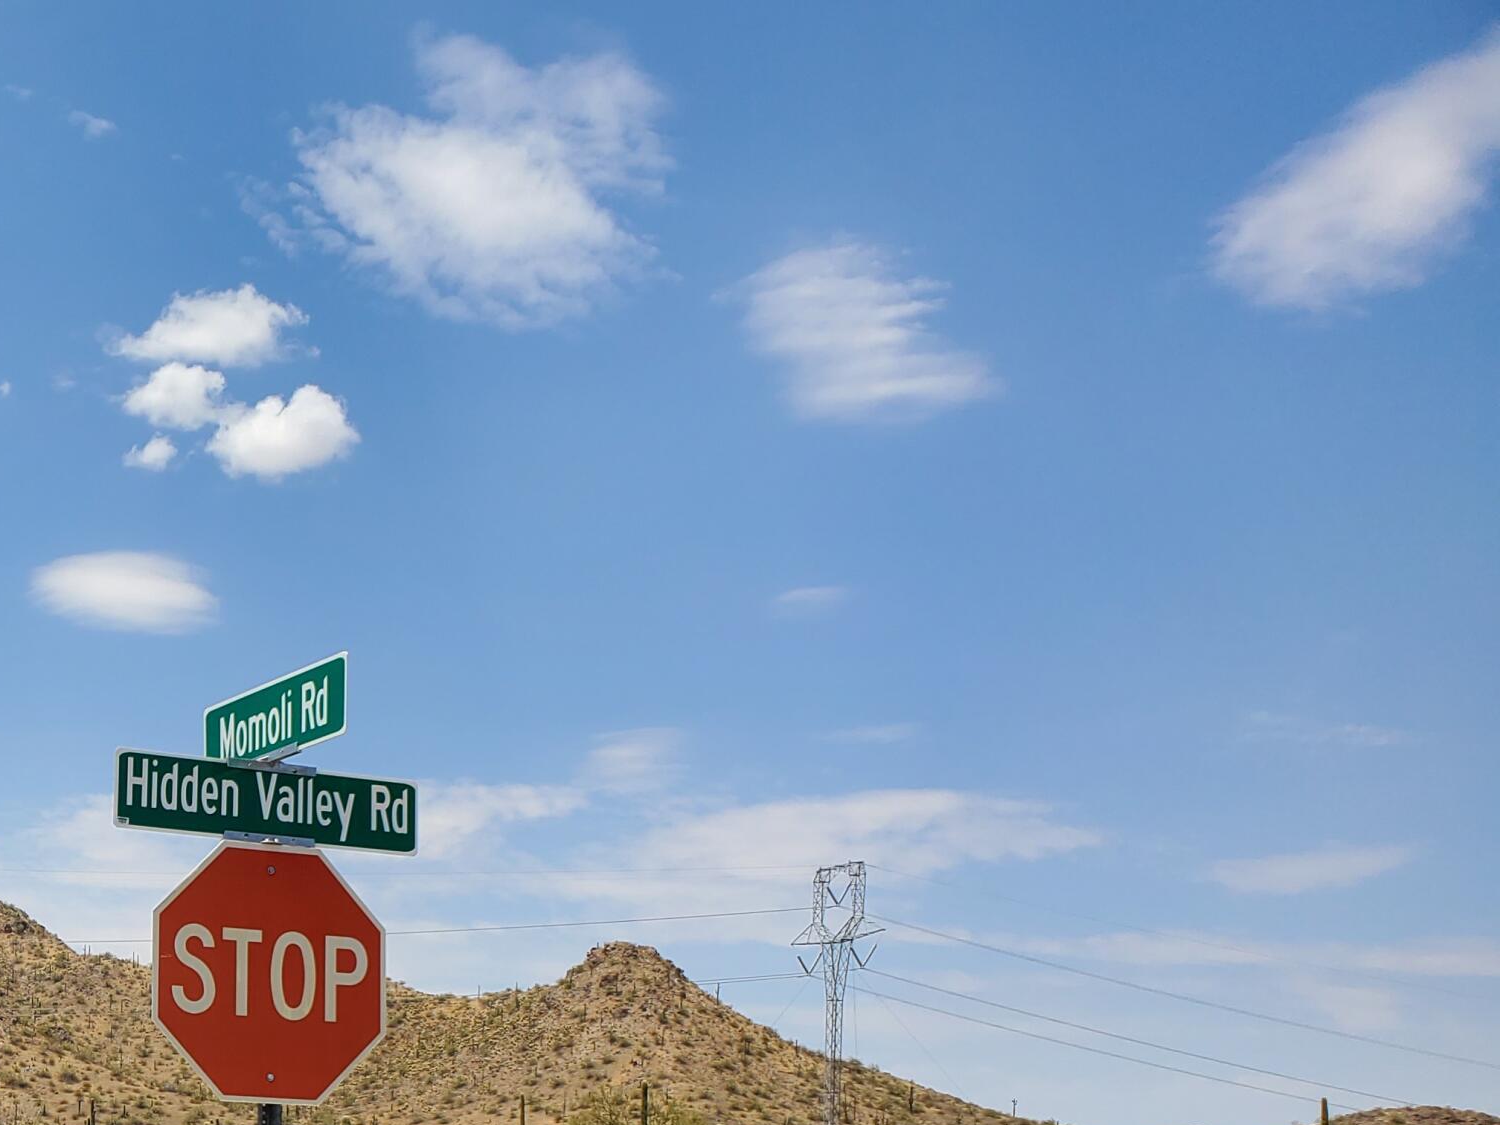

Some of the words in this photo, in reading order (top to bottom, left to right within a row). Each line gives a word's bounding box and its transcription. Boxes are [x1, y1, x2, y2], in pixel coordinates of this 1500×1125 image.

[219, 690, 292, 759] Momoli
[301, 675, 328, 733] Rd
[126, 756, 239, 817] Hidden
[256, 772, 355, 841] Valley
[370, 785, 408, 834] Rd
[171, 923, 368, 1022] STOP
